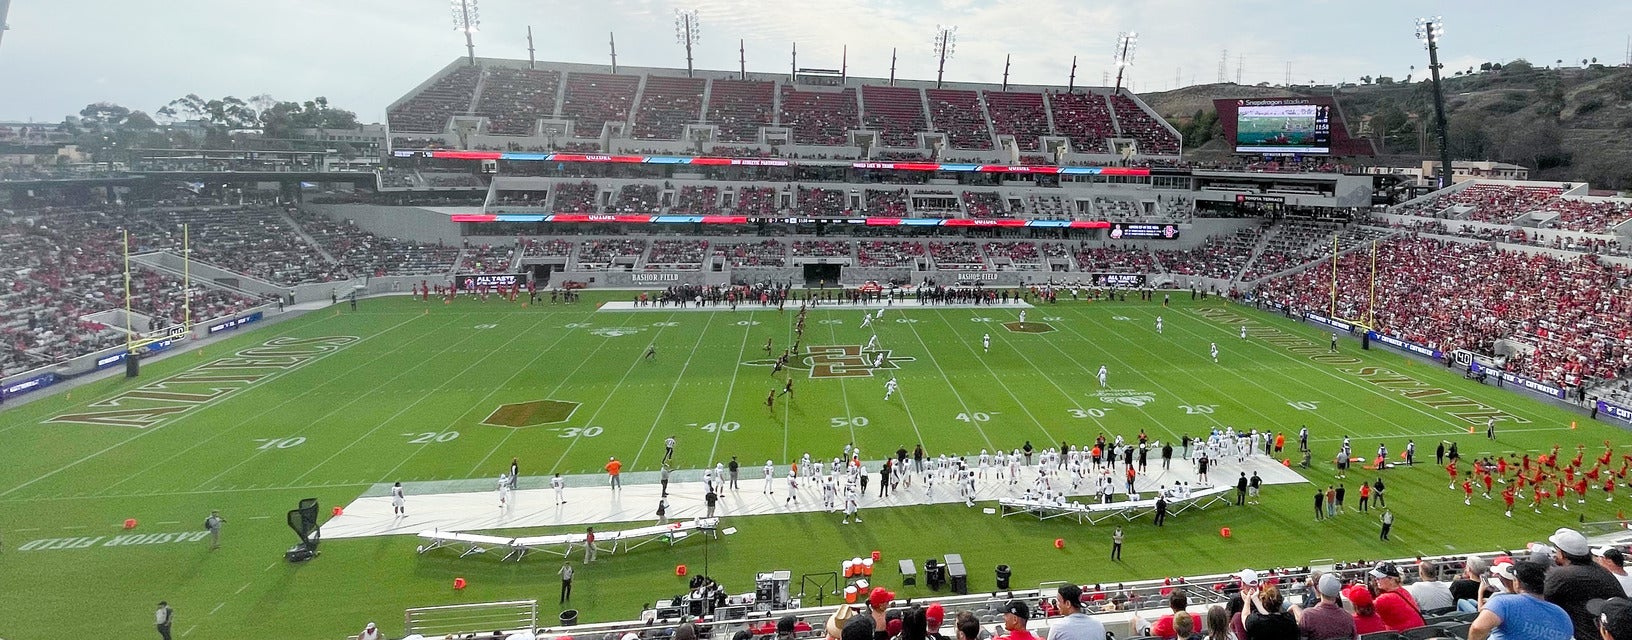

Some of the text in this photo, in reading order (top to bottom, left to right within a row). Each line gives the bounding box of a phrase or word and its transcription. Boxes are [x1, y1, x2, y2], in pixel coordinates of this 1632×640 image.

[632, 273, 679, 281] BASHOR FIELD
[1458, 352, 1470, 364] 40
[40, 336, 361, 429] AZTECS
[1525, 380, 1559, 396] CUTWATER
[1178, 404, 1214, 414] 20
[1287, 401, 1317, 410] 10
[955, 411, 990, 422] 40
[1067, 408, 1105, 418] 30
[701, 421, 741, 433] 40
[830, 416, 870, 428] 50
[407, 431, 460, 444] 20
[557, 426, 604, 438] 30
[256, 436, 307, 450] 10
[18, 530, 211, 551] BASHOR FIELD
